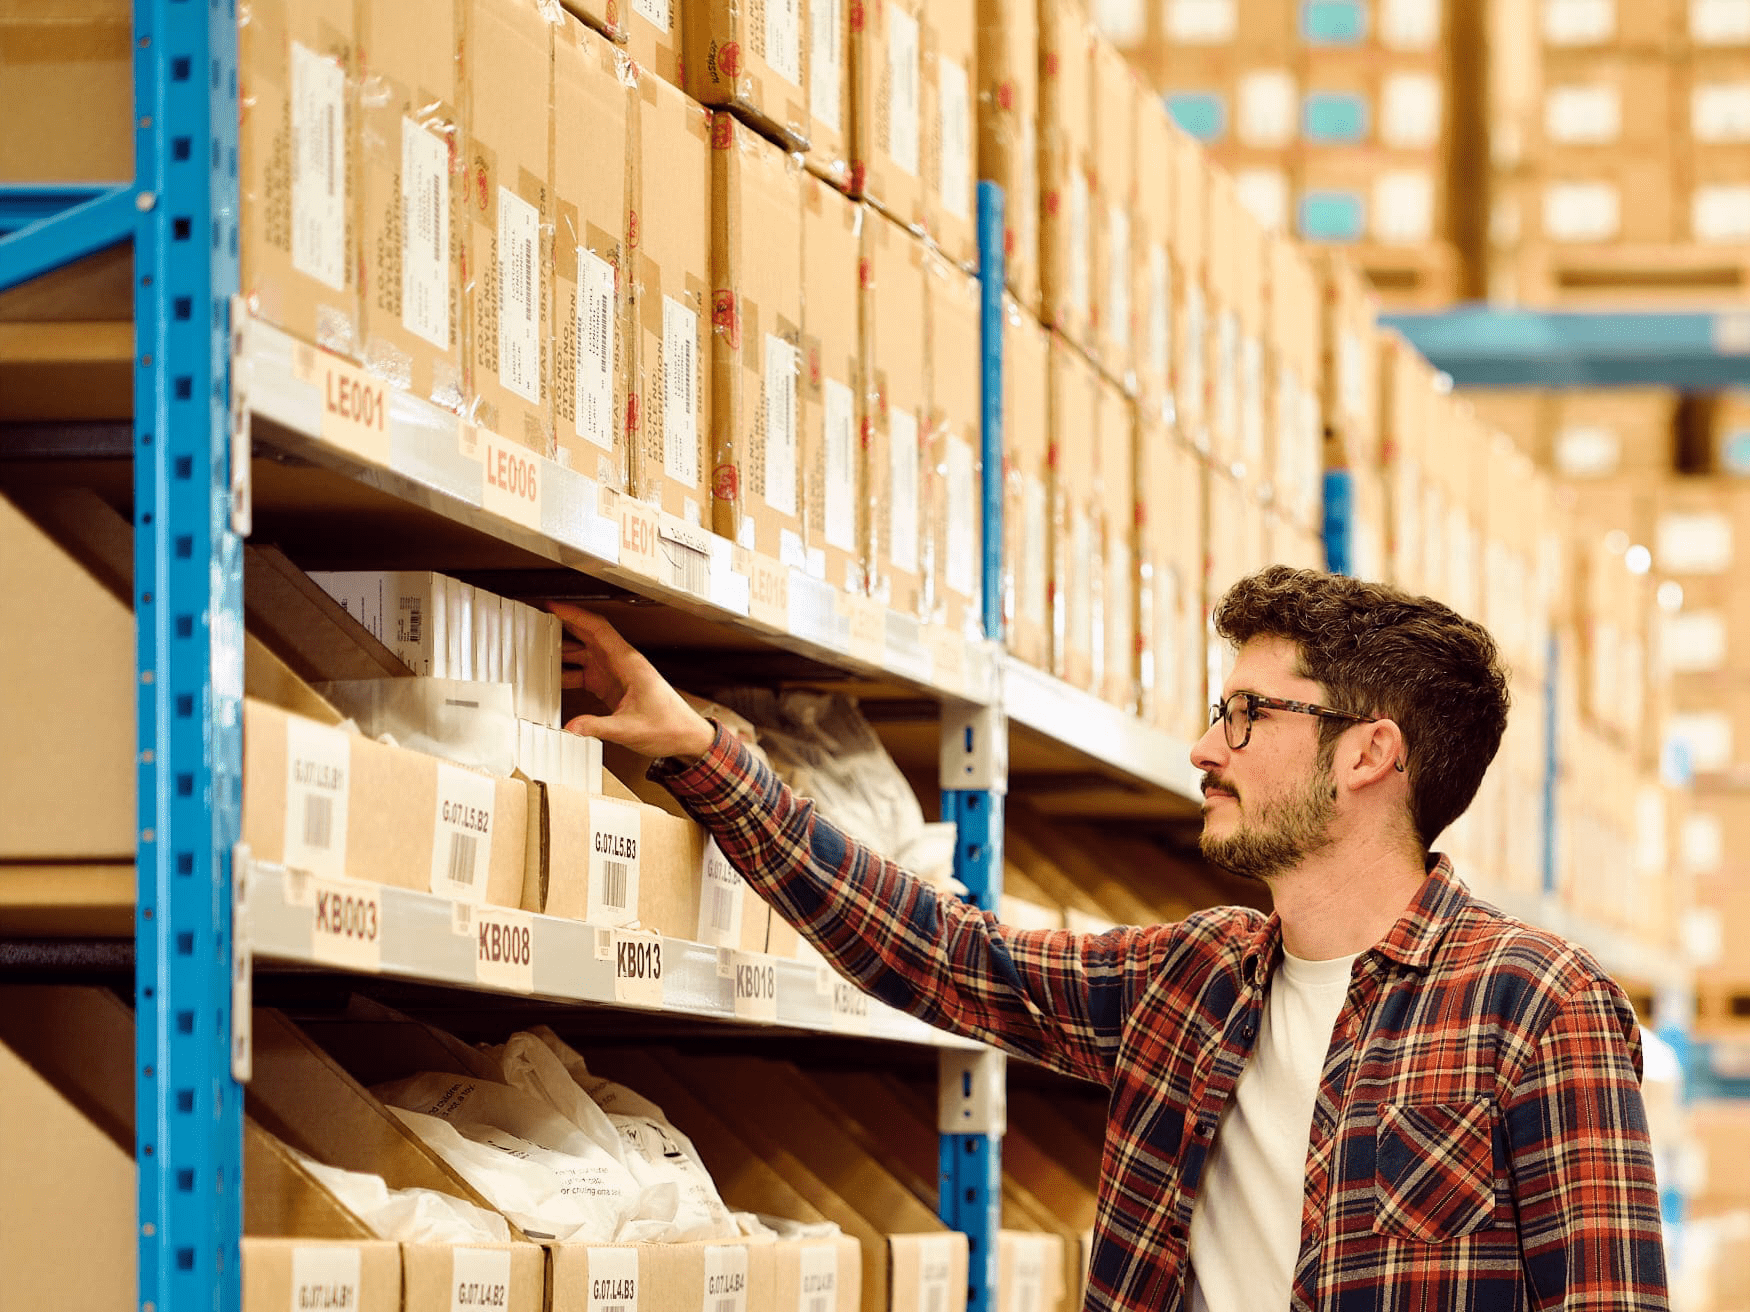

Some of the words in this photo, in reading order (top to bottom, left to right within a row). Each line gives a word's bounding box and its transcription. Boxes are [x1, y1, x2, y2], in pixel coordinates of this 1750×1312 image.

[490, 231, 498, 374] DESCRIPTION:
[327, 368, 384, 432] LE001
[487, 445, 536, 502] LE006
[622, 511, 655, 558] LE01
[443, 800, 488, 833] G.07.L5.B2
[596, 832, 636, 859] G.07.L5.B3
[315, 890, 376, 942] KB003
[479, 921, 530, 966] KB008
[616, 941, 660, 979] KB013
[736, 964, 773, 1000] KB018
[459, 1282, 504, 1306] G.07.L4.B2
[594, 1279, 634, 1300] G.07.L4.B3
